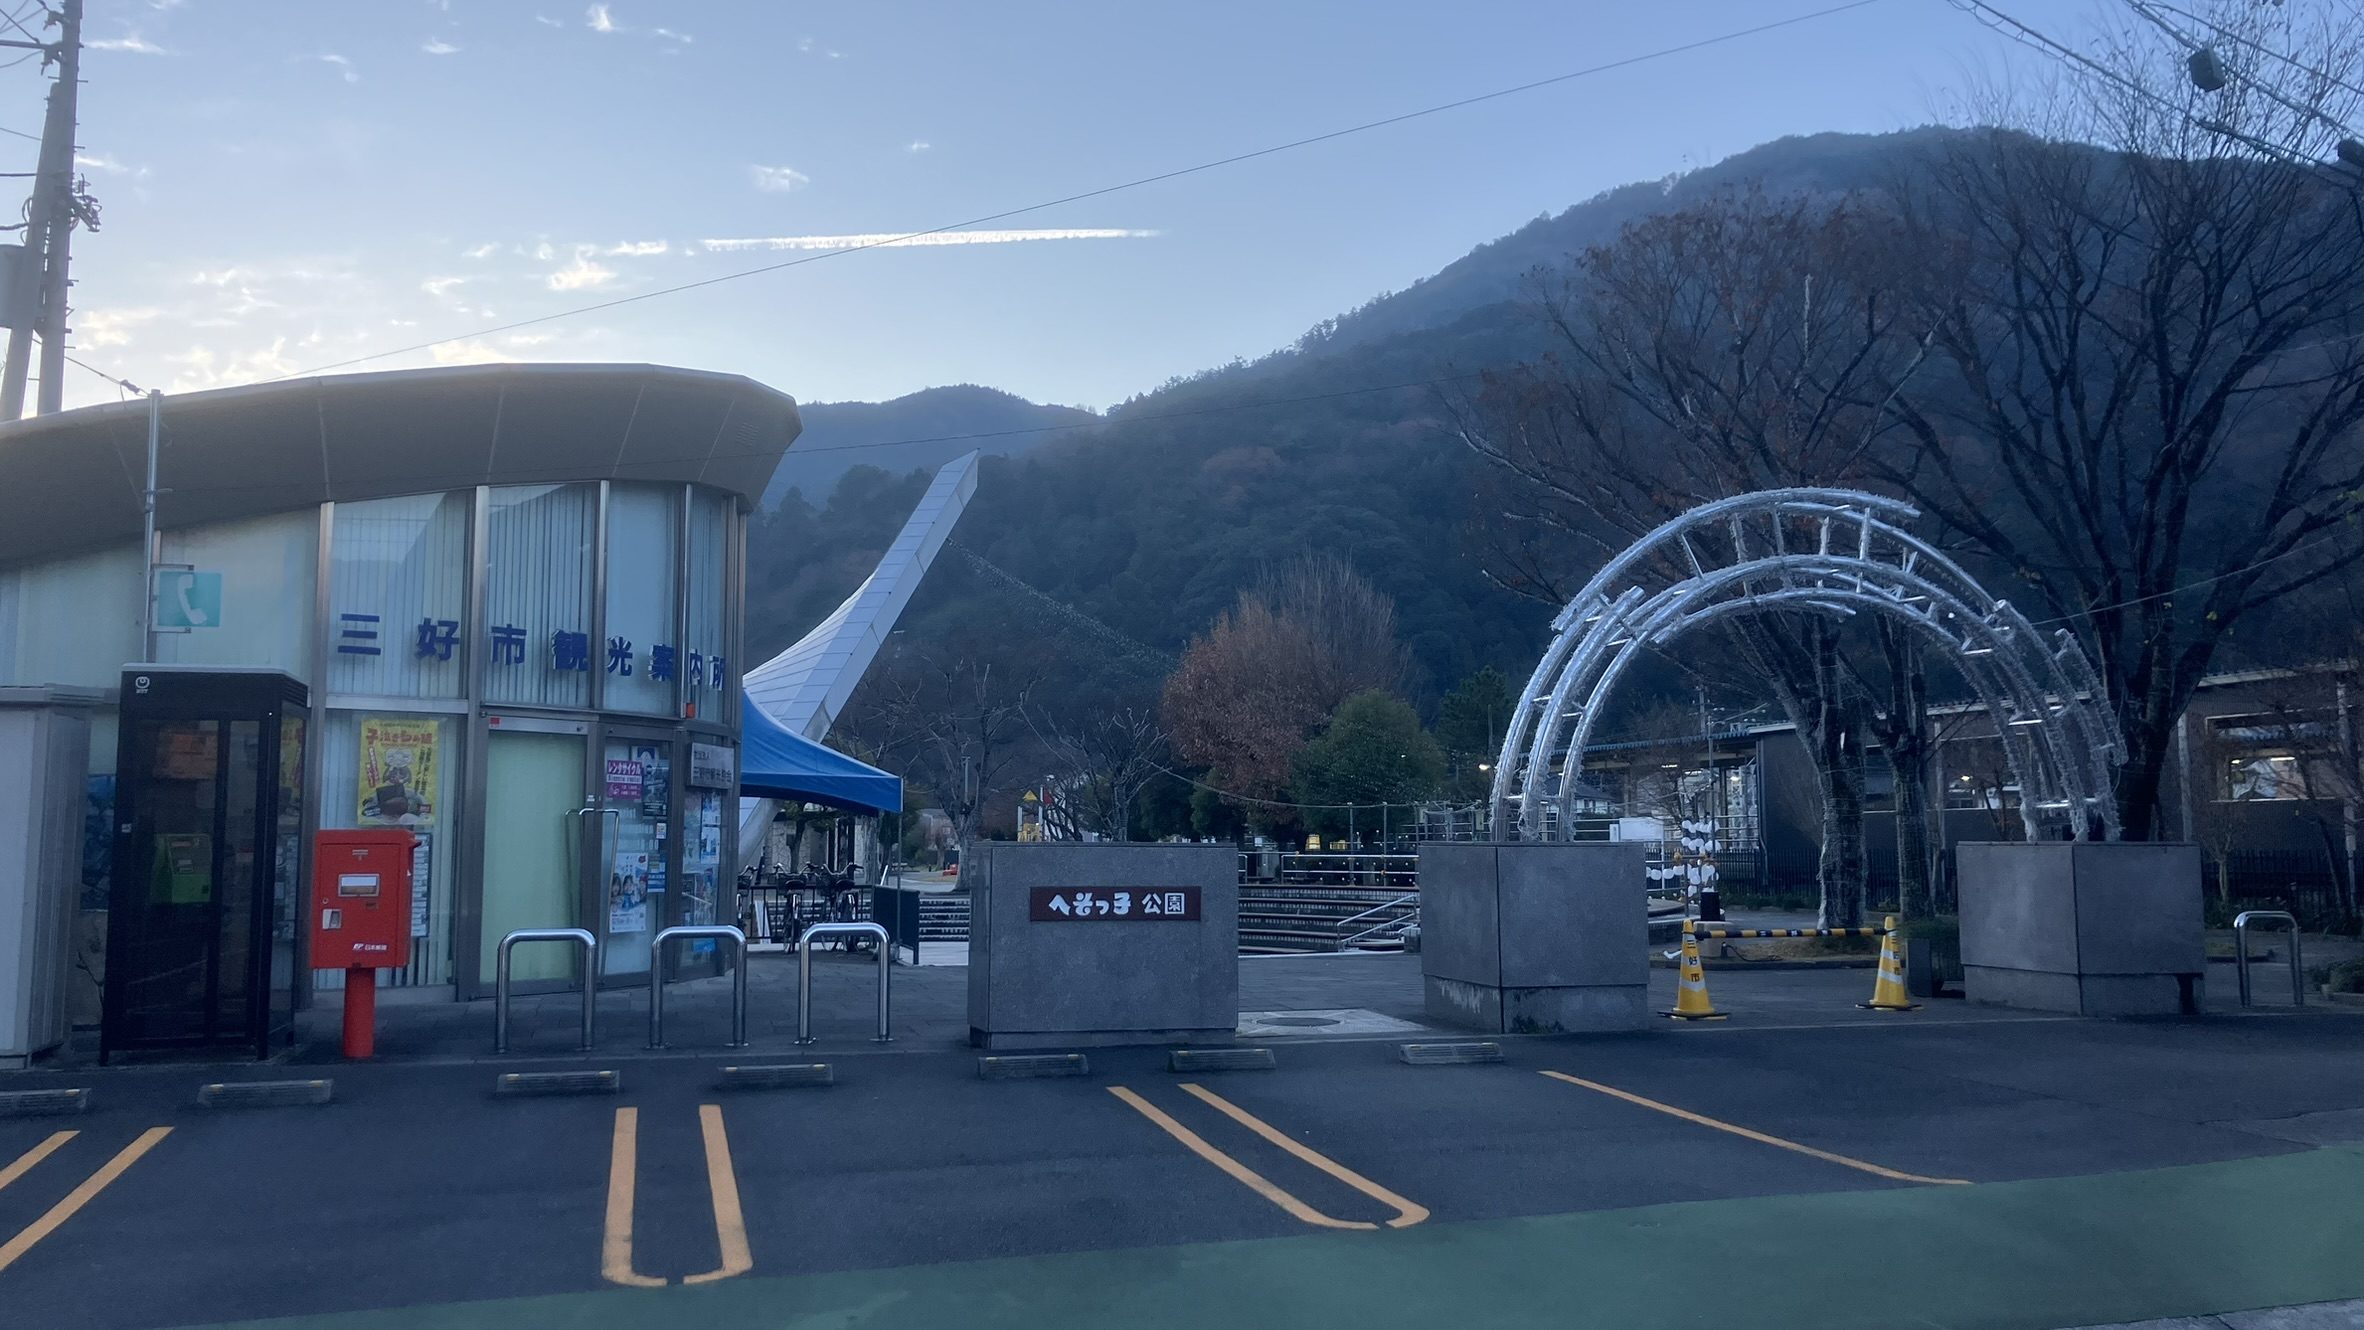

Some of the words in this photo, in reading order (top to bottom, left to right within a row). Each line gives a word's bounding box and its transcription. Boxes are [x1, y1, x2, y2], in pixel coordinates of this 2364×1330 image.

[337, 613, 726, 691] 三好市観光案内所
